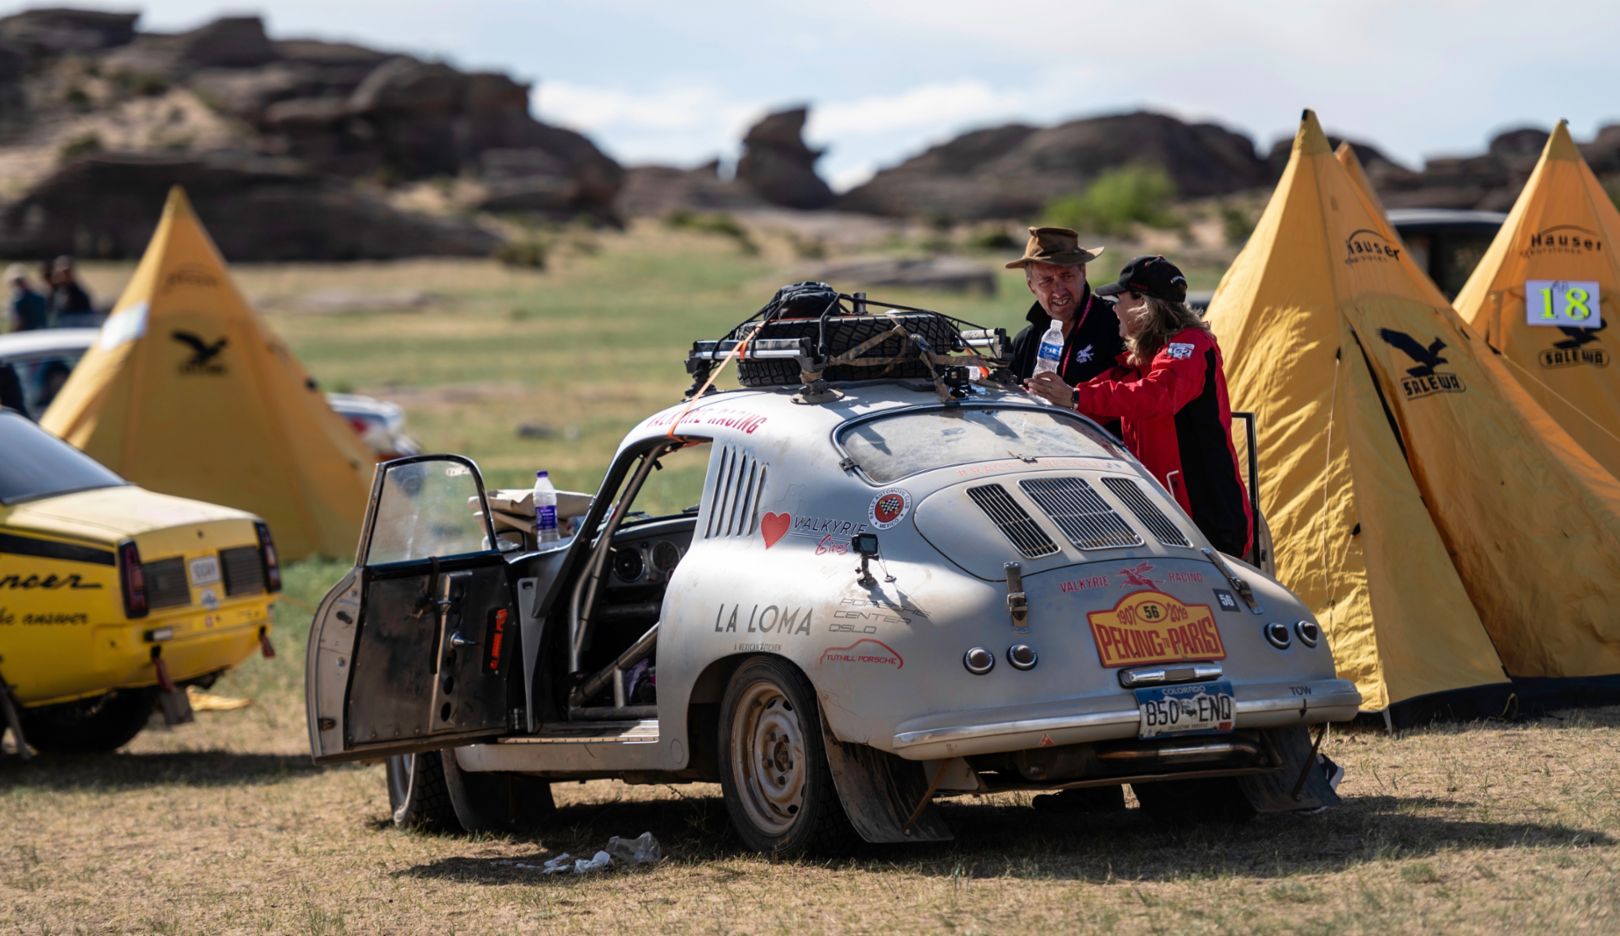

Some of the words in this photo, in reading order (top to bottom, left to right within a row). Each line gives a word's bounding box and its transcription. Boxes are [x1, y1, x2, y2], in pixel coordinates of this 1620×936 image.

[1531, 233, 1601, 251] Hauser
[1538, 286, 1592, 321] 18
[1545, 350, 1604, 365] SALEWA
[1403, 375, 1461, 396] SALEWA
[794, 516, 869, 534] VALKYRIE
[1060, 575, 1110, 592] VALKYRIE
[1168, 572, 1204, 584] RACING
[1218, 593, 1235, 607] 56
[22, 612, 88, 626] answer
[714, 603, 740, 633] LA
[747, 604, 814, 636] LOMA
[833, 610, 912, 625] CENTER
[1117, 604, 1137, 626] 1907
[1143, 605, 1160, 619] 56
[1166, 602, 1189, 622] 2019
[828, 623, 878, 634] OSLO
[1095, 623, 1166, 661] PEKING
[1167, 616, 1221, 655] PARIS
[826, 654, 857, 662] TUTHILL
[857, 655, 897, 664] PORSCHE
[1161, 685, 1207, 696] COLORADO
[1288, 686, 1312, 696] TOW
[1146, 700, 1180, 727] 850
[1198, 693, 1233, 722] ENQ
